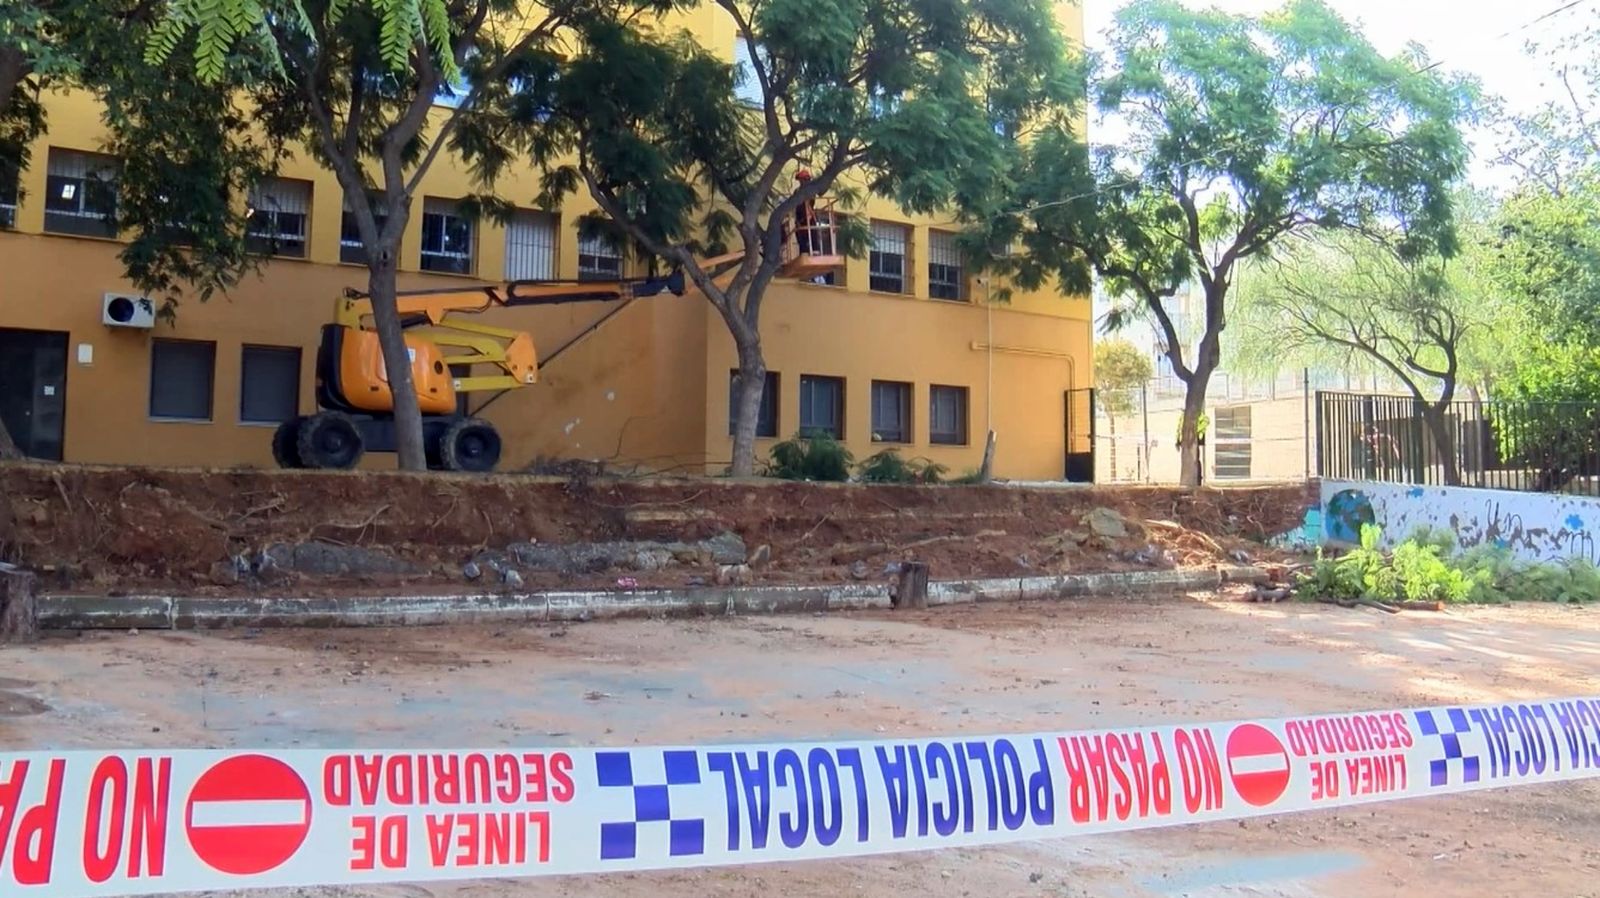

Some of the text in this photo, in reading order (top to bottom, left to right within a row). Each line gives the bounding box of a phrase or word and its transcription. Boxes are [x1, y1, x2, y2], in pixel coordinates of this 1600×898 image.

[1284, 711, 1414, 757] SEGURIDAD
[1468, 704, 1560, 779] LOCAL
[323, 752, 575, 806] SEGURIDAD
[706, 738, 1055, 851] POLICIA LOCAL
[1057, 728, 1223, 824] NO PASAR
[1309, 753, 1407, 801] LINEA DE
[83, 755, 172, 884] NO
[350, 811, 550, 870] LINEA DE
